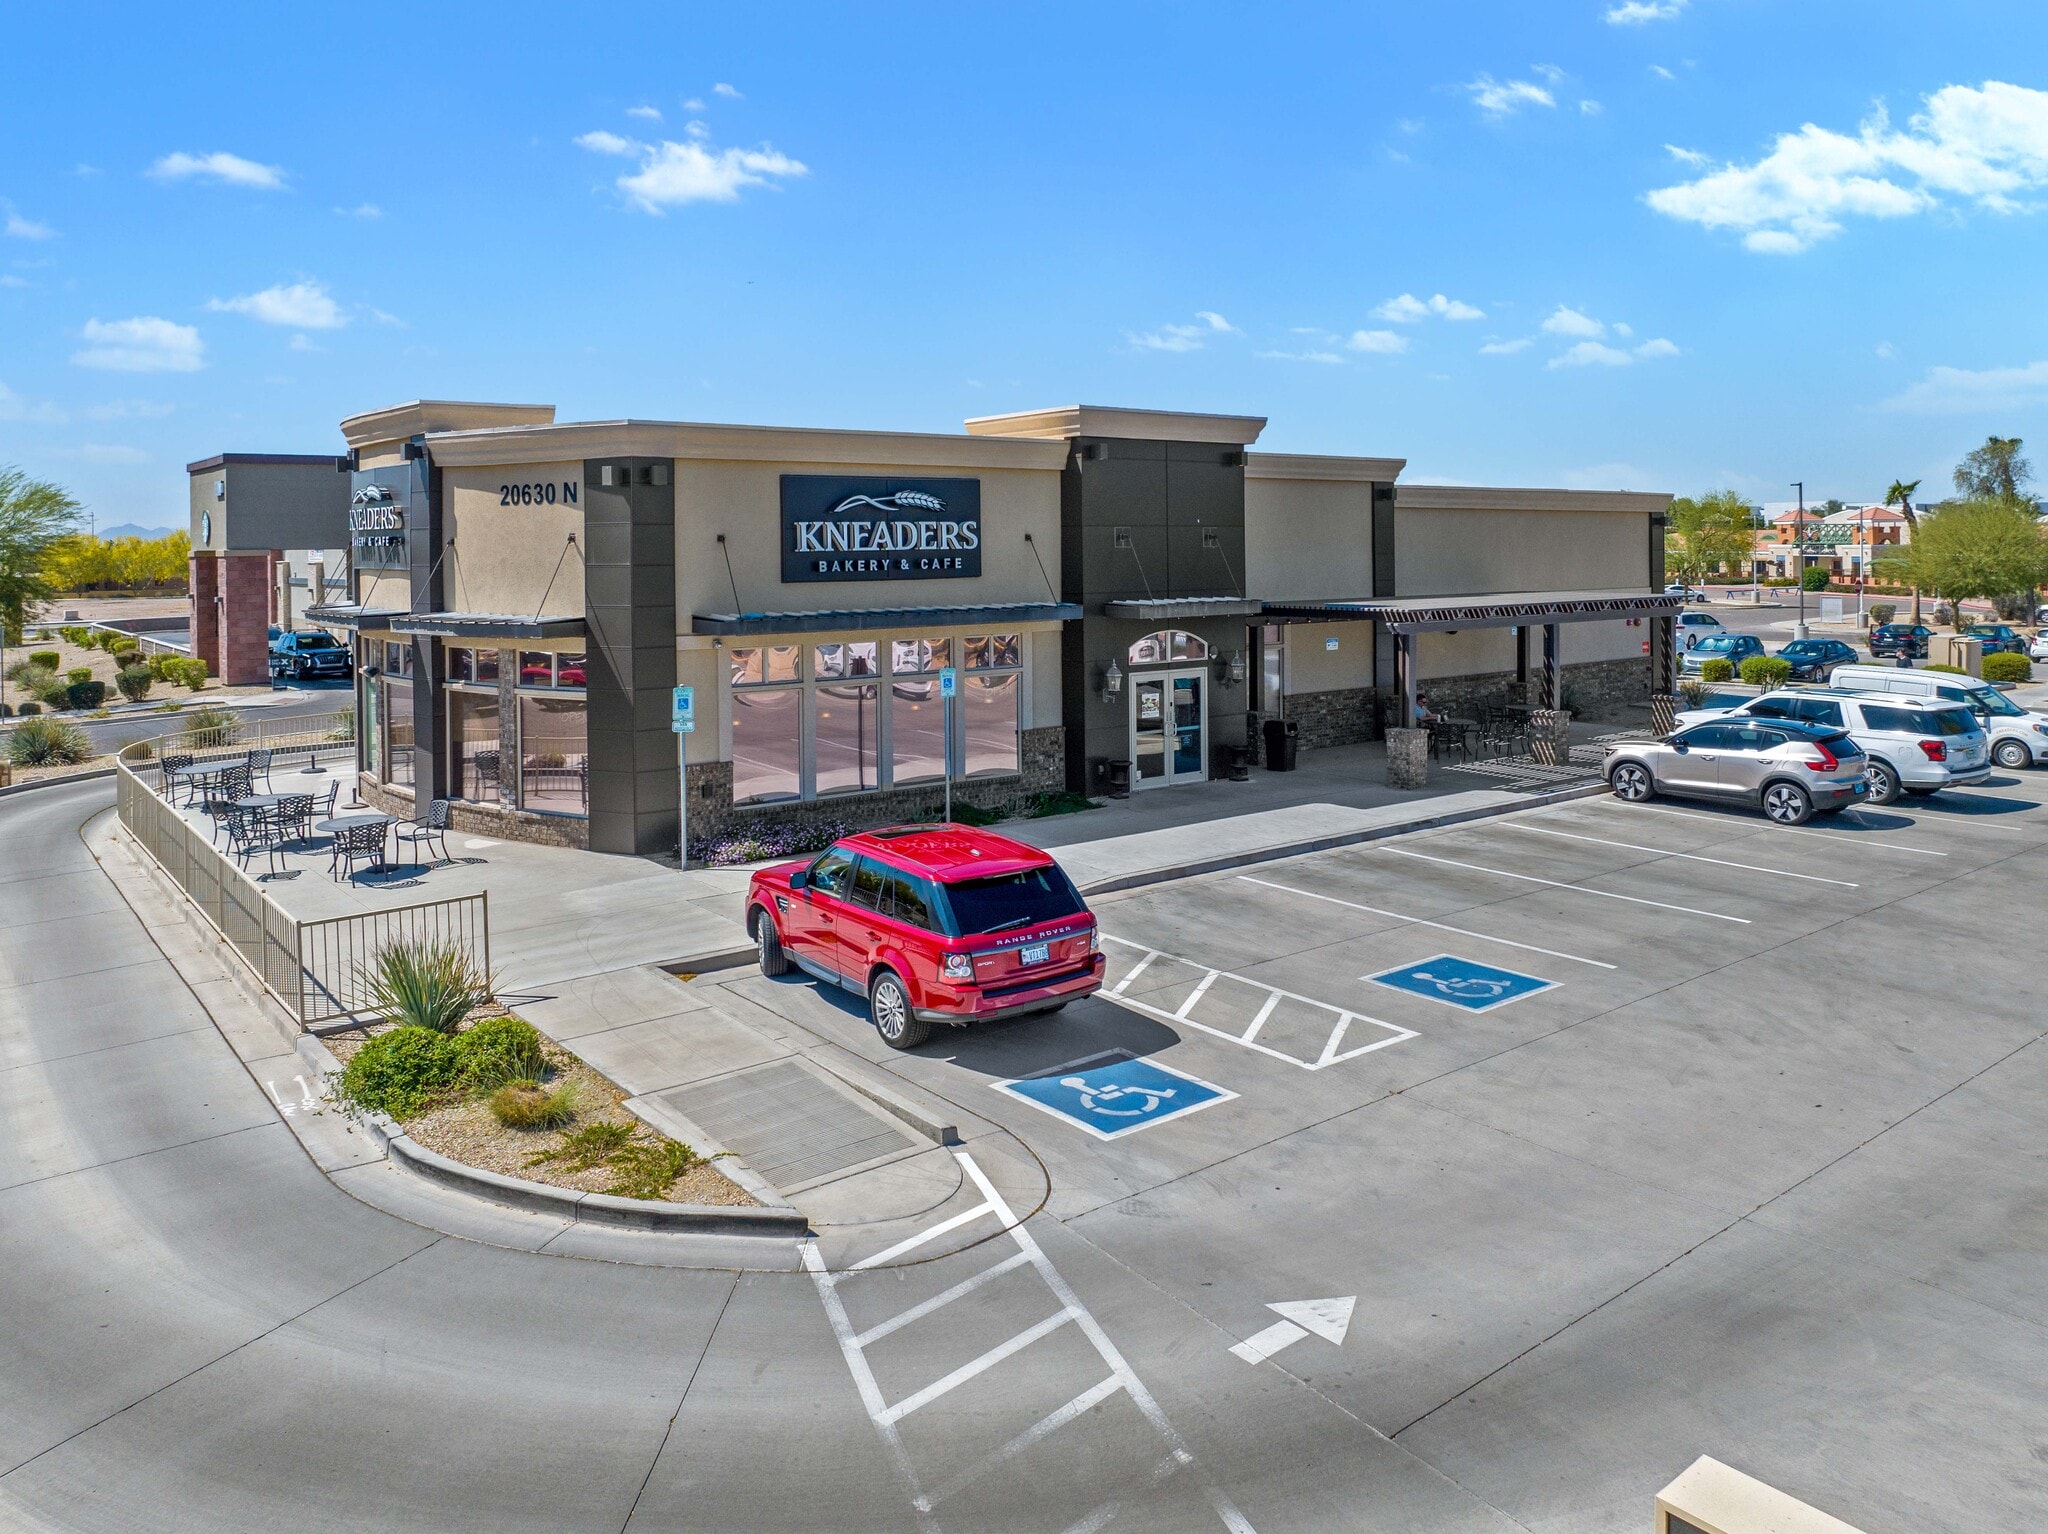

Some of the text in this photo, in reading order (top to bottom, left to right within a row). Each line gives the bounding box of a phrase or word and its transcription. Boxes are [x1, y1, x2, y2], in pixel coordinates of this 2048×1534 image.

[500, 481, 578, 507] 20630 N
[349, 507, 395, 531] KNEADERS
[794, 521, 979, 552] KNEADERS
[818, 557, 962, 573] BAKERY & CAFE
[996, 925, 1072, 946] RANGE ROVER
